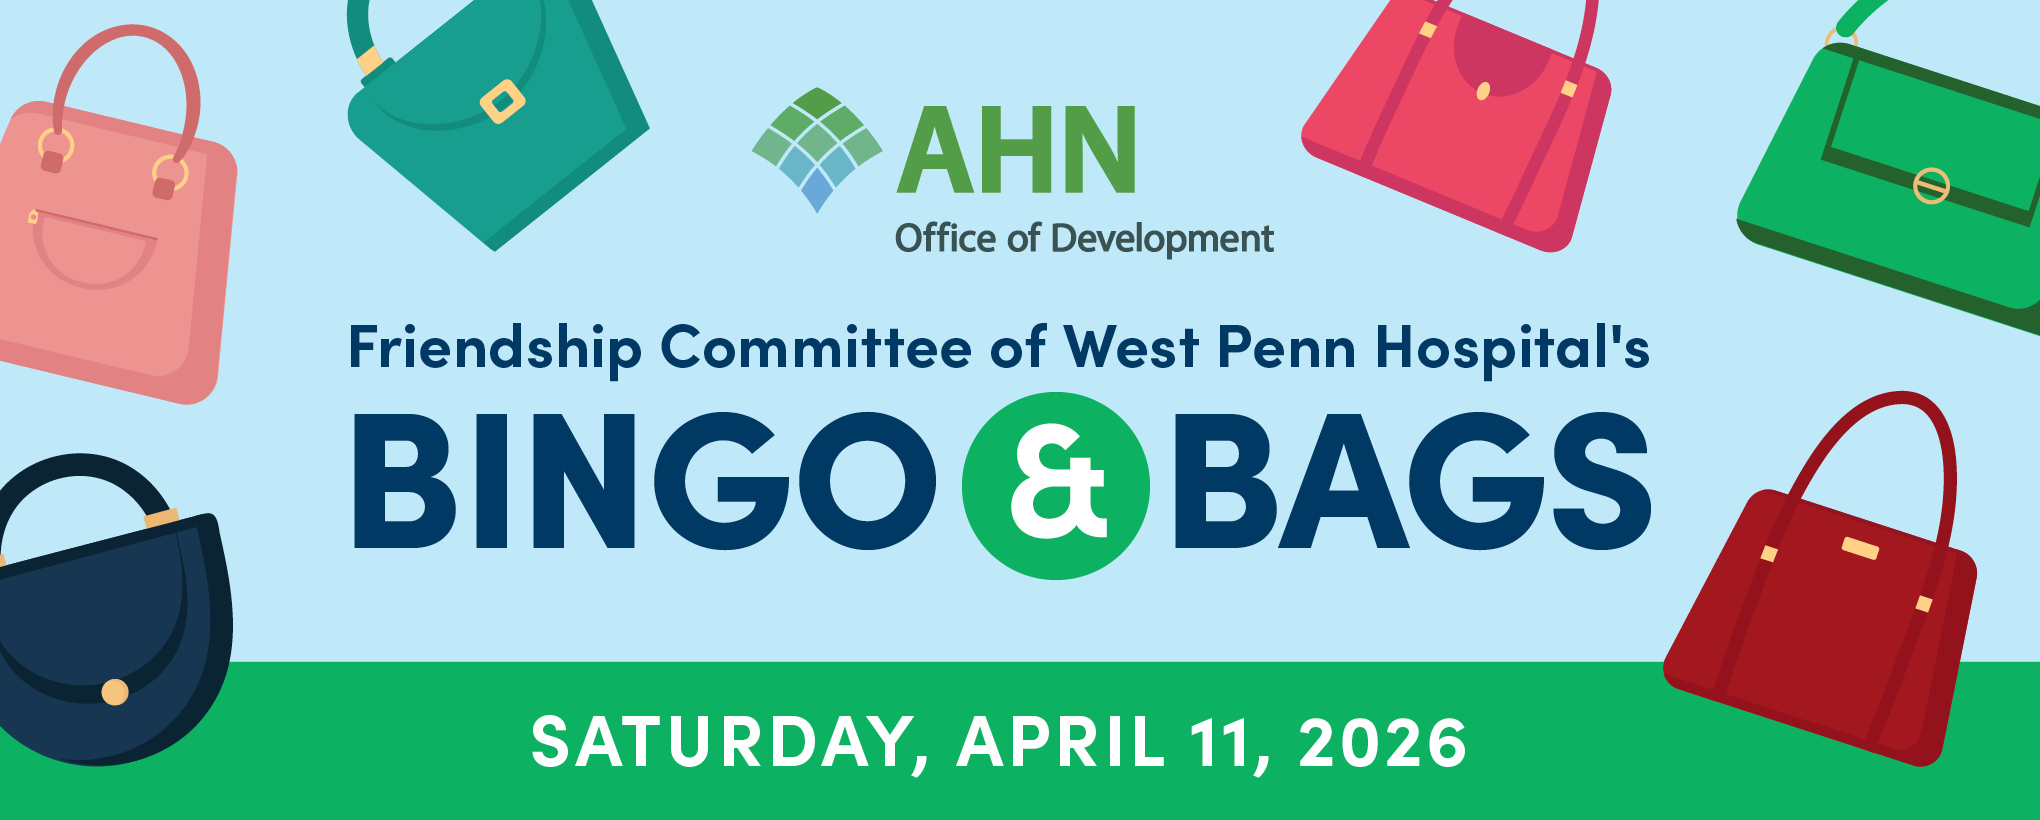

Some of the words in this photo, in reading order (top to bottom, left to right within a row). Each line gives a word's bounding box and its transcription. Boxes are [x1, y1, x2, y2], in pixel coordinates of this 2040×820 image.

[896, 106, 1135, 193] AHN
[895, 221, 996, 252] Office
[1007, 221, 1043, 252] of
[1052, 222, 1274, 260] Development
[350, 323, 641, 382] Friendship
[661, 324, 971, 368] Committee
[991, 323, 1047, 368] of
[1063, 325, 1199, 368] West
[1220, 325, 1354, 368] Penn
[1378, 323, 1649, 382] Hospital's
[354, 411, 936, 551] BINGO
[1011, 423, 1107, 539] &
[1175, 412, 1651, 551] BAGS
[532, 715, 927, 778] SATURDAY,
[956, 716, 1164, 766] APRIL
[1191, 718, 1269, 778] 11,
[1300, 717, 1465, 767] 2026
